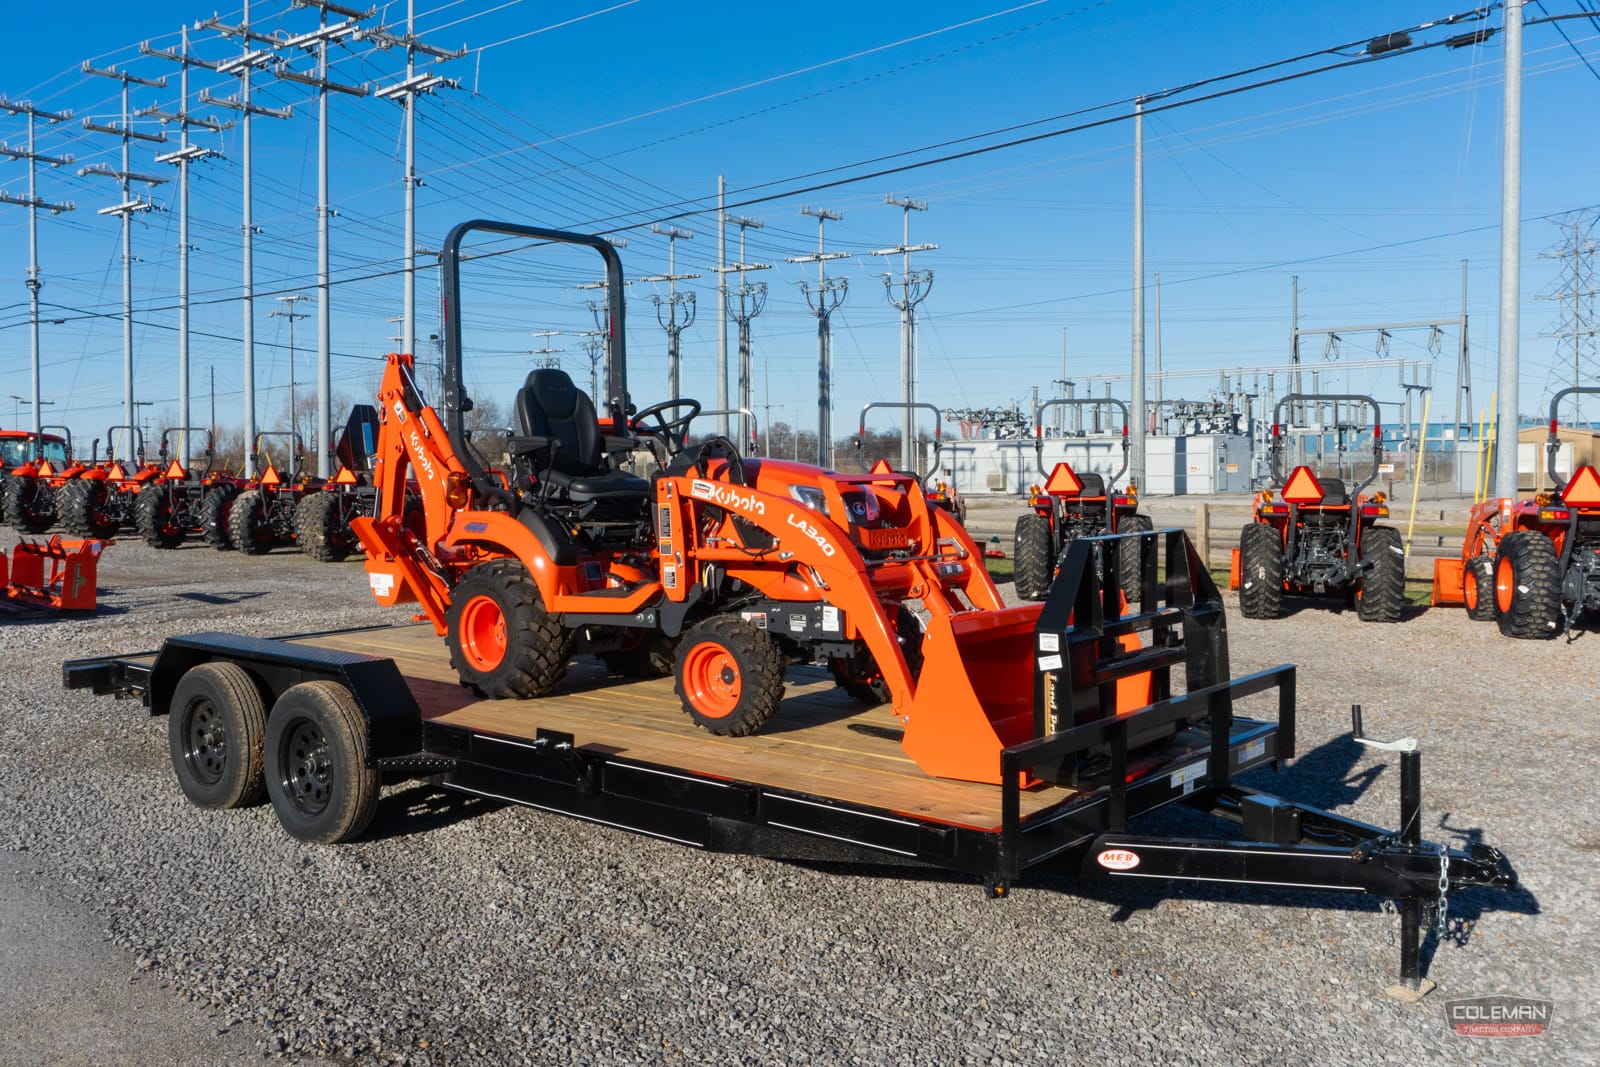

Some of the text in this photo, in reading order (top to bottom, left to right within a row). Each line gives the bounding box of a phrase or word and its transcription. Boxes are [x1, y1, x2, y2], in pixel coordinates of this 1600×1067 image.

[410, 431, 434, 480] Kubota
[714, 486, 766, 515] Kubota
[787, 513, 836, 558] LA340
